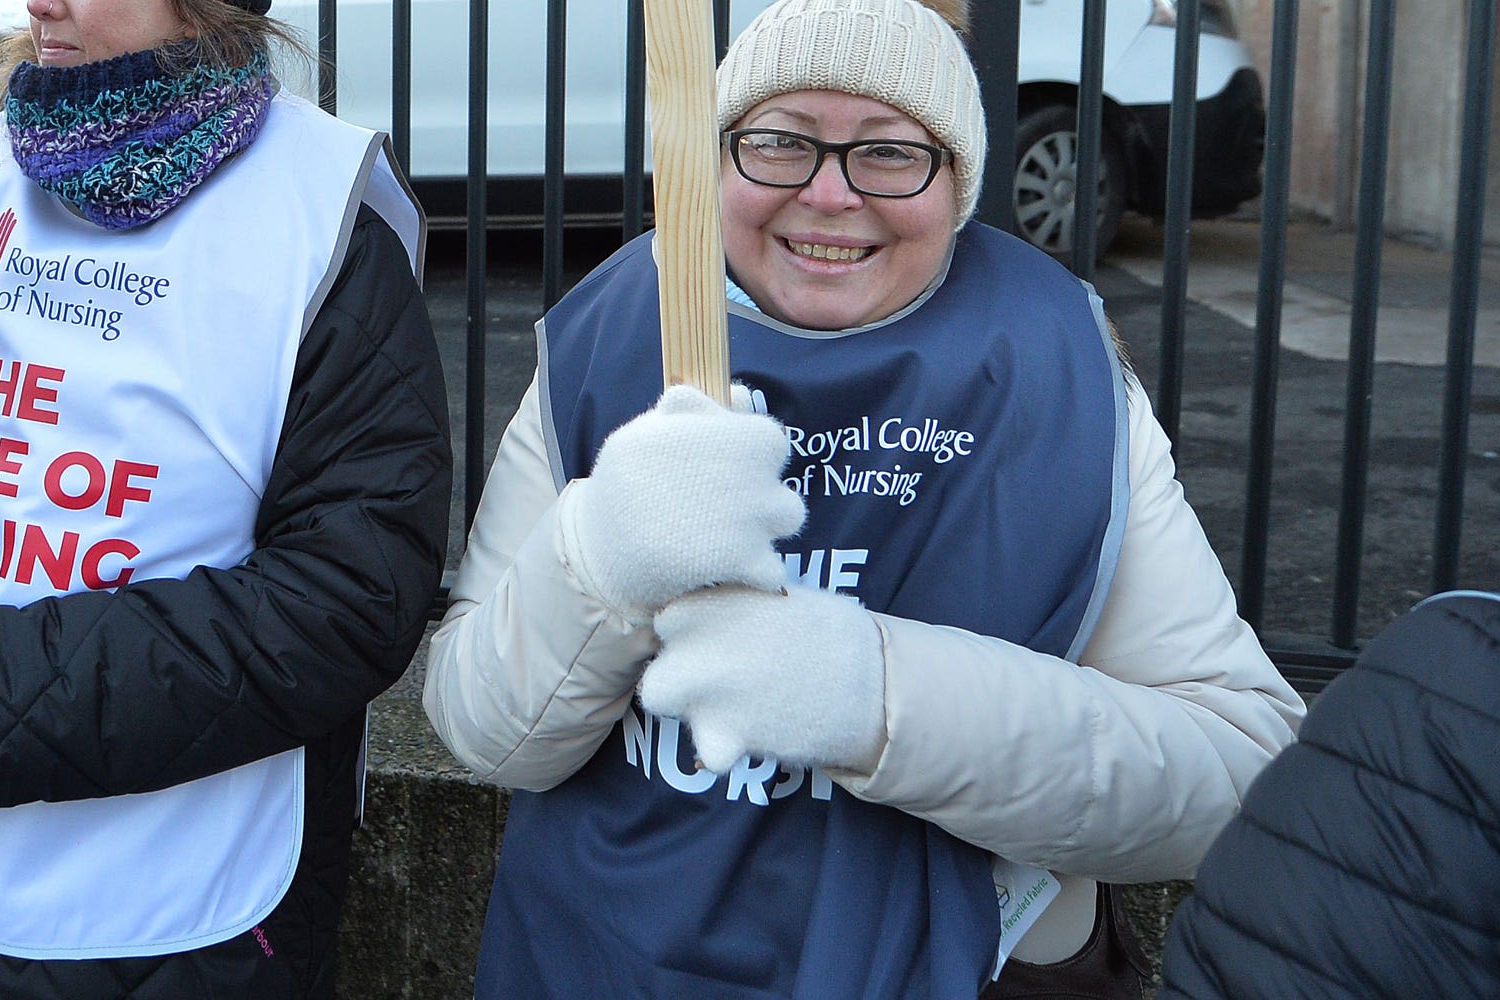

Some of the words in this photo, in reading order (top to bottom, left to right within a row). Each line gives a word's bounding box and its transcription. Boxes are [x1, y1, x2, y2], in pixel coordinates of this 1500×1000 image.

[4, 247, 71, 289] Royal
[73, 257, 170, 306] College
[26, 289, 123, 341] Nursing
[785, 416, 870, 463] Royal
[878, 417, 975, 464] College
[44, 450, 160, 518] OF
[782, 464, 816, 496] of
[824, 464, 923, 506] Nursing
[779, 549, 869, 606] HE
[1003, 896, 1031, 929] Recycled
[1026, 878, 1048, 901] Fabric
